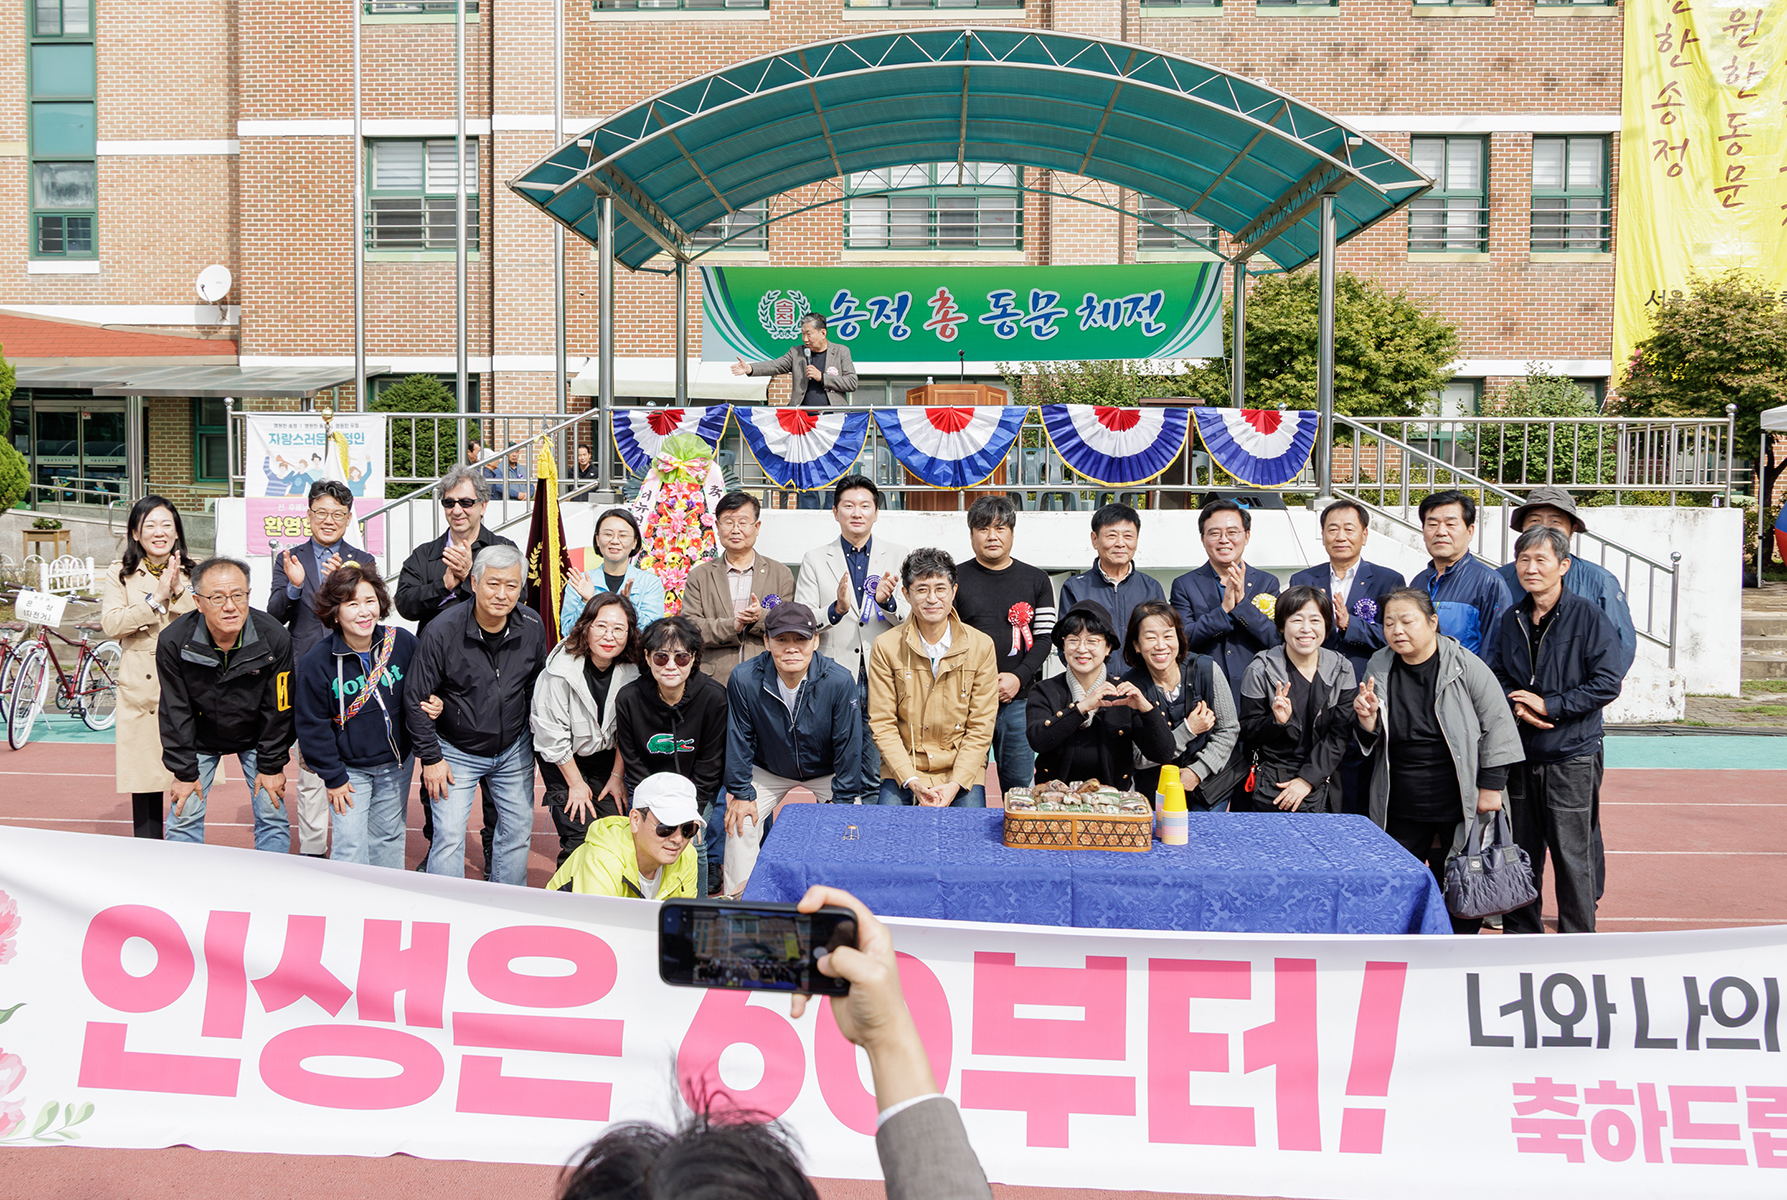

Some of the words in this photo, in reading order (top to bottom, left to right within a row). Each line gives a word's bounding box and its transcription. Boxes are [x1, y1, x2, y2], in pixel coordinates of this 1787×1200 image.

[1651, 81, 1690, 177] 송정
[1714, 112, 1752, 208] 동문
[826, 290, 913, 340] 송정
[925, 287, 967, 341] 총
[980, 289, 1068, 340] 동문
[1076, 291, 1165, 337] 체전
[269, 432, 326, 446] 자랑스러운
[77, 904, 625, 1122] 인생은
[677, 950, 1408, 1155] 60부터!
[1465, 972, 1617, 1049] 너와
[1630, 975, 1781, 1052] 나의
